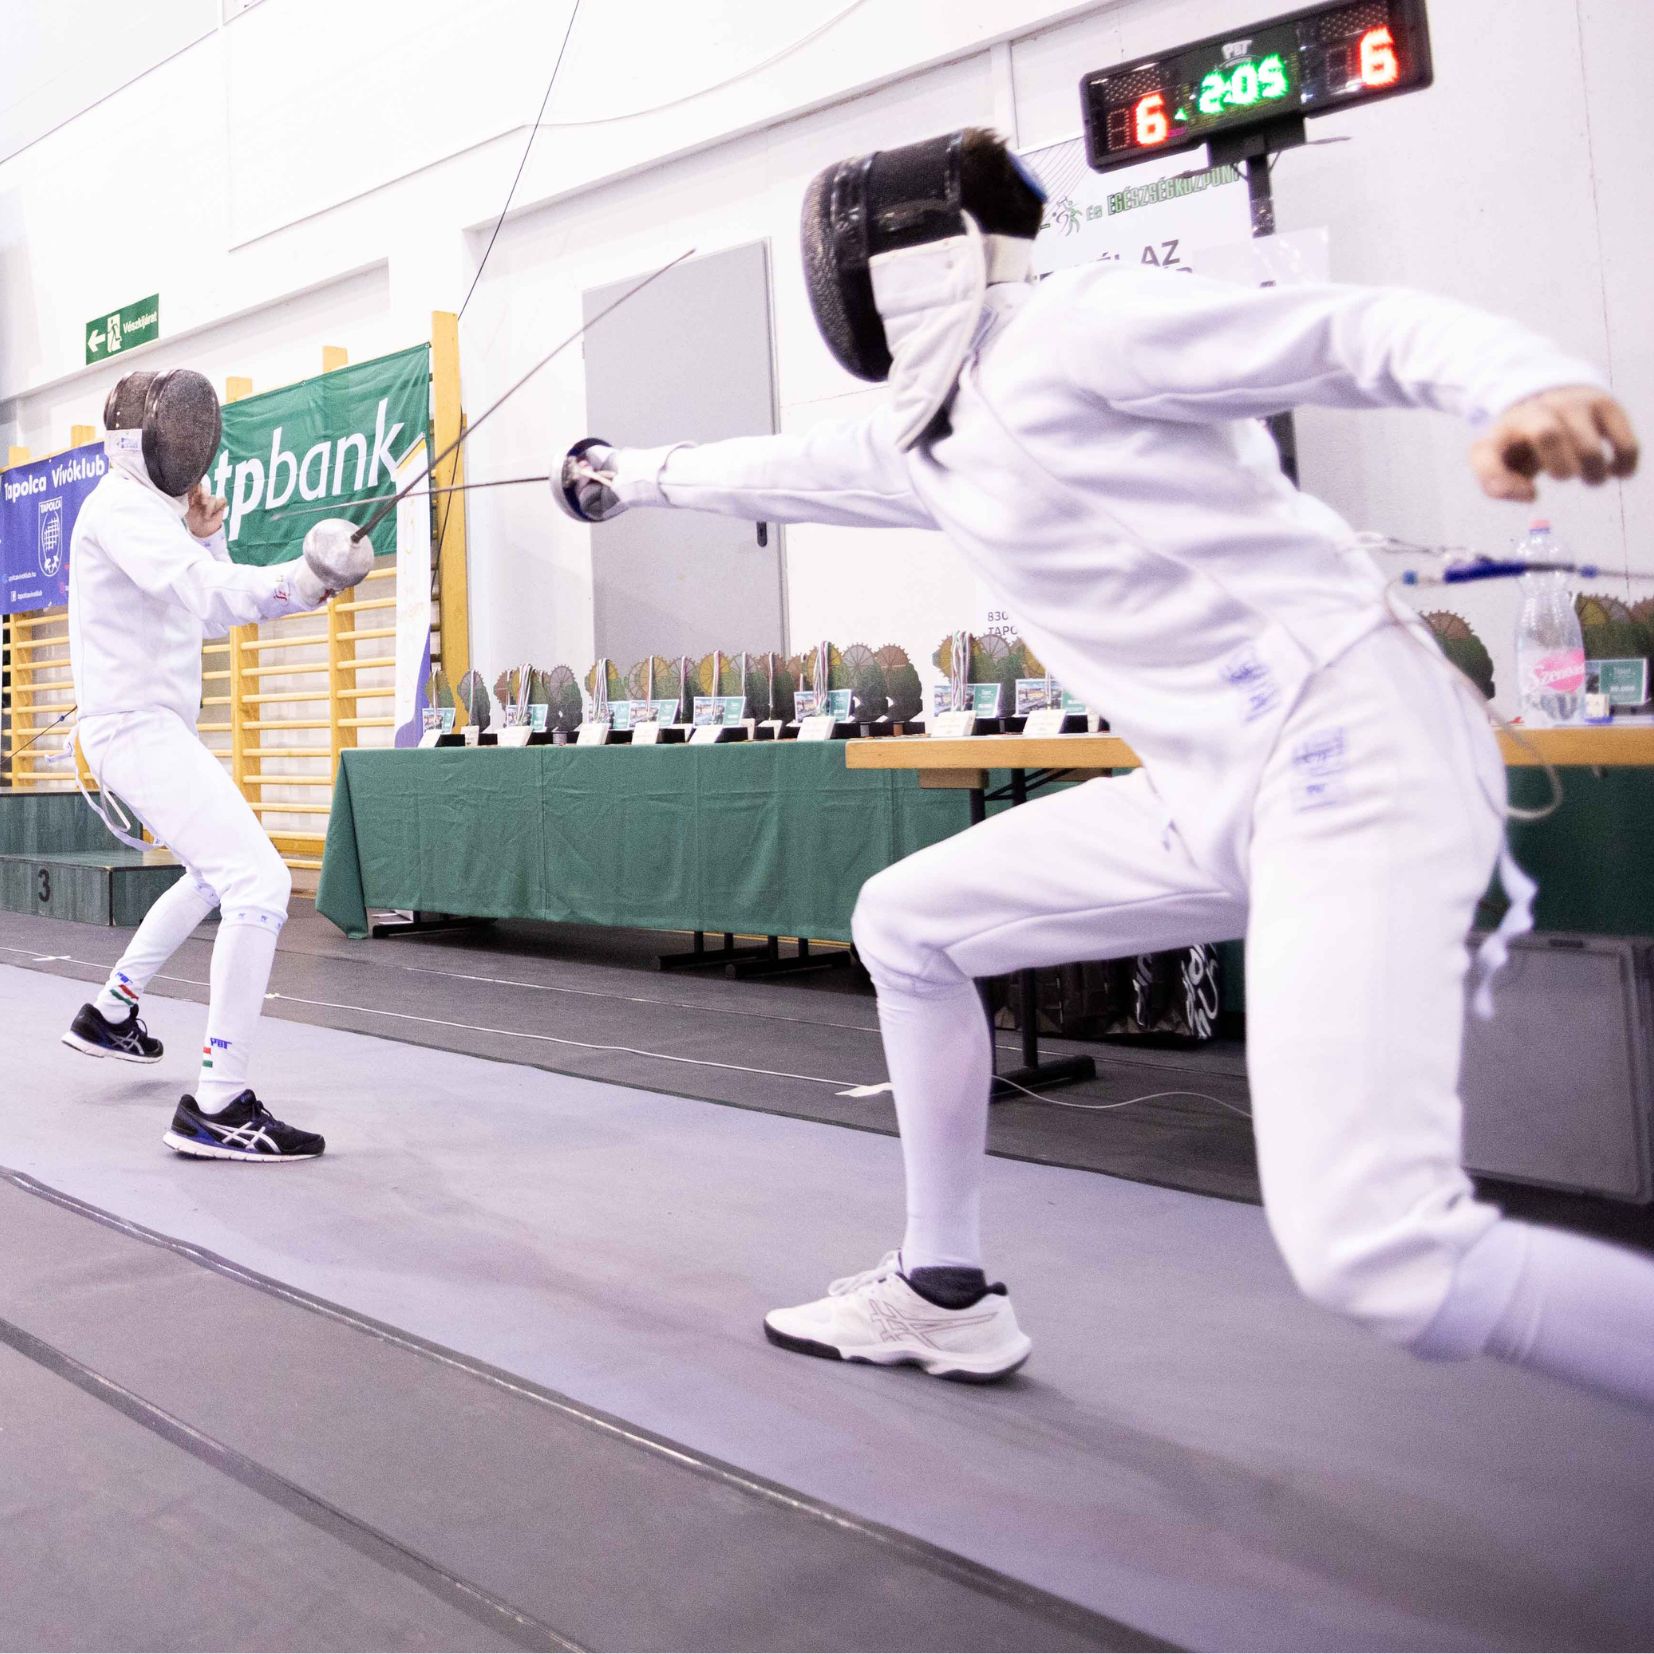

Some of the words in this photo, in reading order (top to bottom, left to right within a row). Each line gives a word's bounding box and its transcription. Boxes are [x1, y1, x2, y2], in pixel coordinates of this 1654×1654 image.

[1360, 24, 1398, 87] 6
[1134, 92, 1168, 145] 6
[1140, 239, 1181, 267] AZ
[4, 474, 47, 503] Tapolca
[52, 454, 105, 489] Vívóklub
[38, 868, 51, 903] 3
